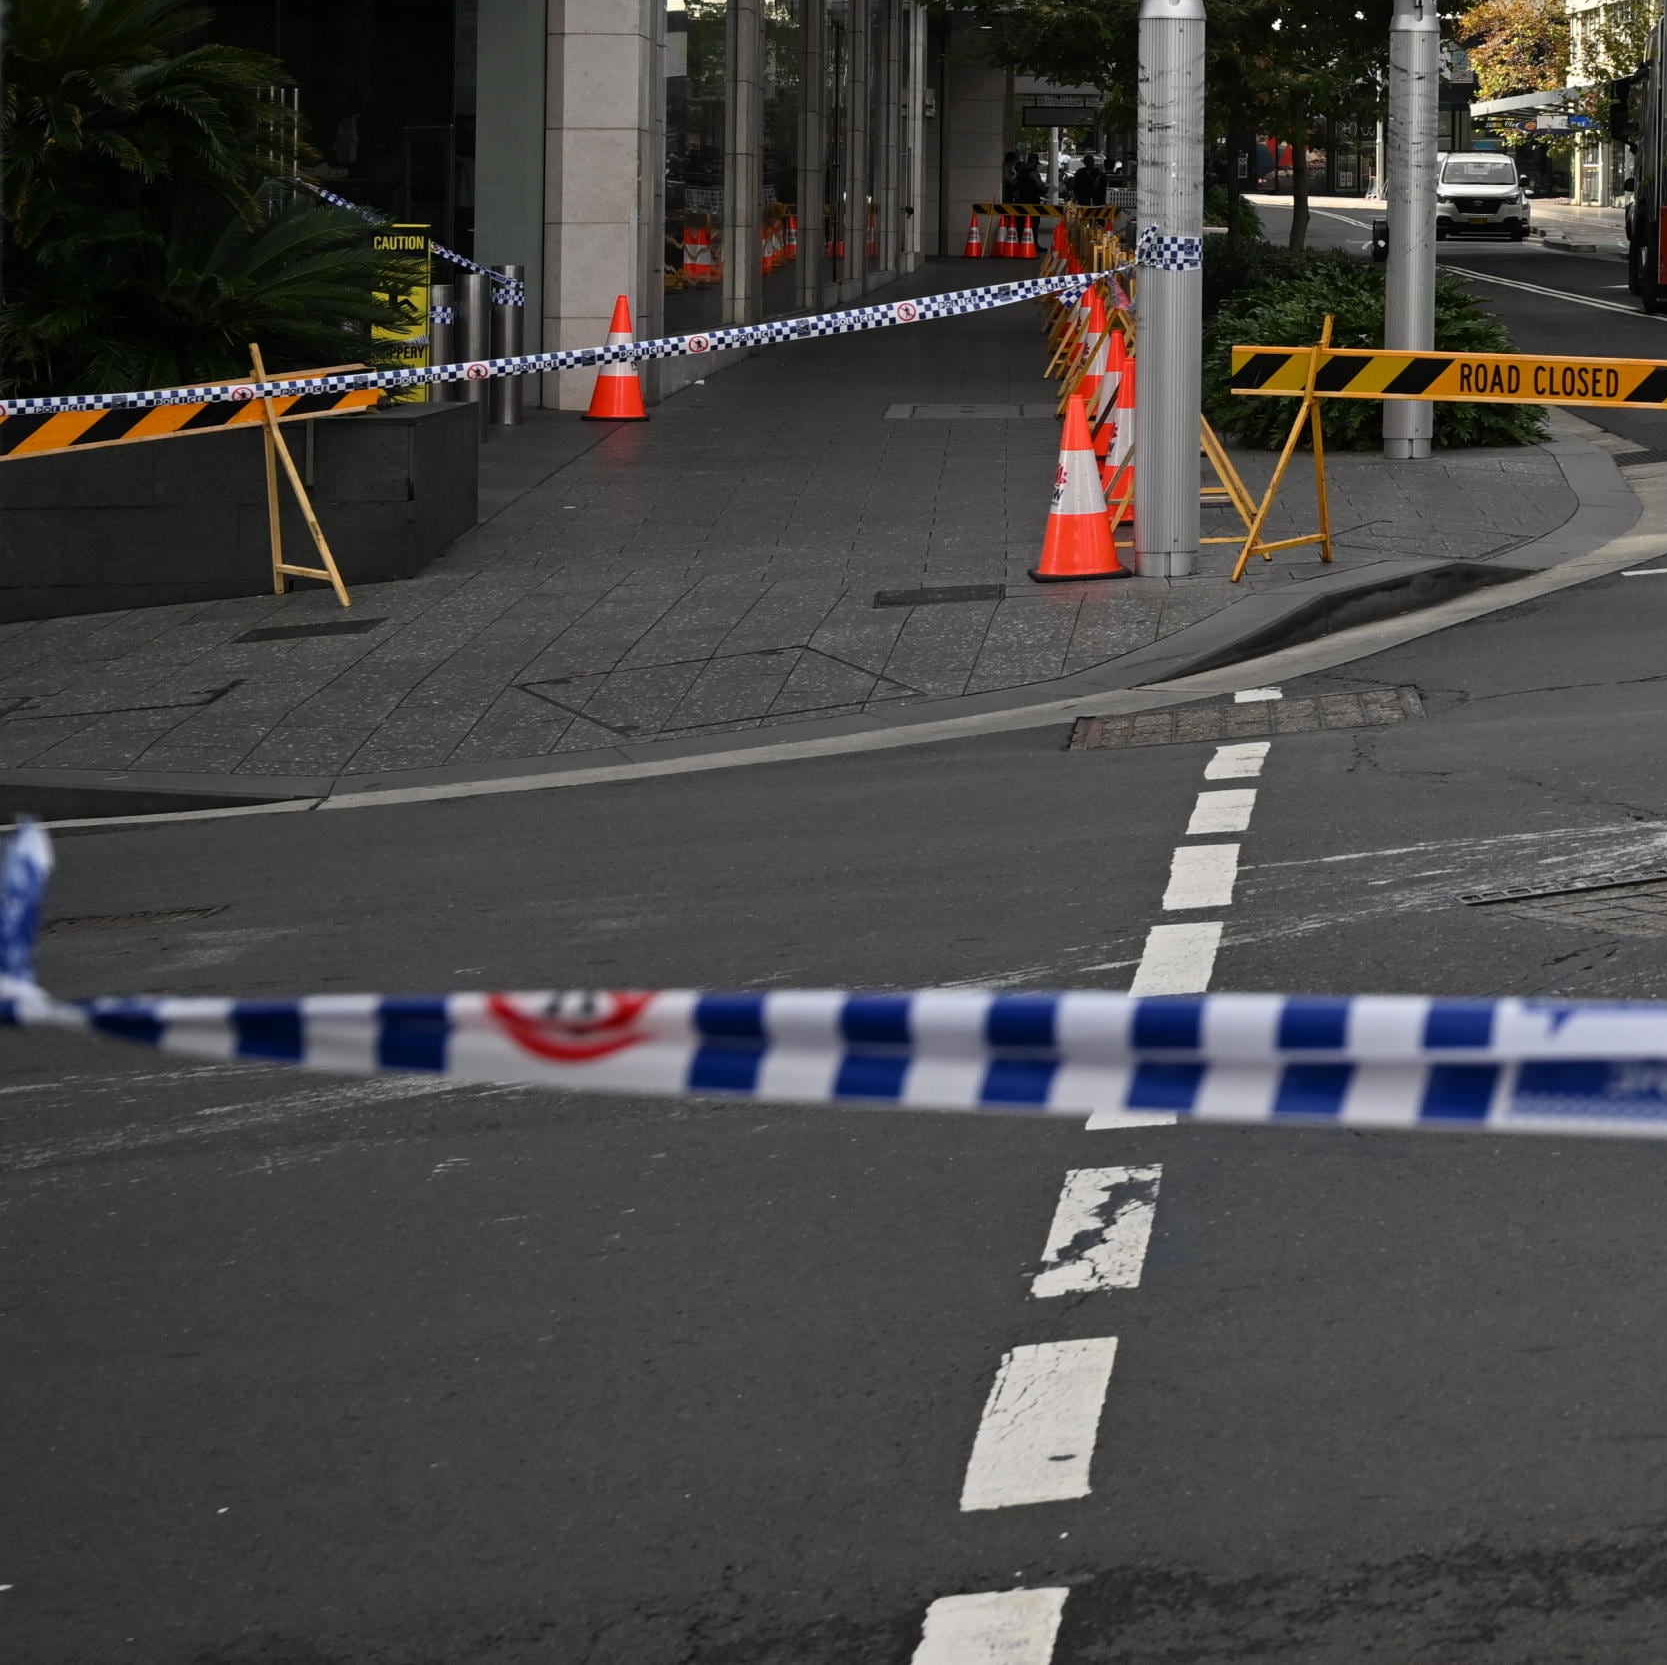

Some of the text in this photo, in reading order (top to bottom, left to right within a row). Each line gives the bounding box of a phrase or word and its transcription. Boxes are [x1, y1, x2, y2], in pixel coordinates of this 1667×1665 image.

[373, 235, 425, 251] CAUTION
[936, 295, 977, 310] POLICE
[832, 313, 875, 327] POLICE
[731, 330, 776, 342] POLICE
[620, 346, 664, 359] POLICE
[513, 359, 560, 372] POLICE
[394, 373, 441, 386] POLICE
[1459, 363, 1620, 399] ROAD CLOSED
[280, 385, 330, 396] POLICE
[154, 395, 206, 406] POLICE
[34, 404, 86, 414] POLICE
